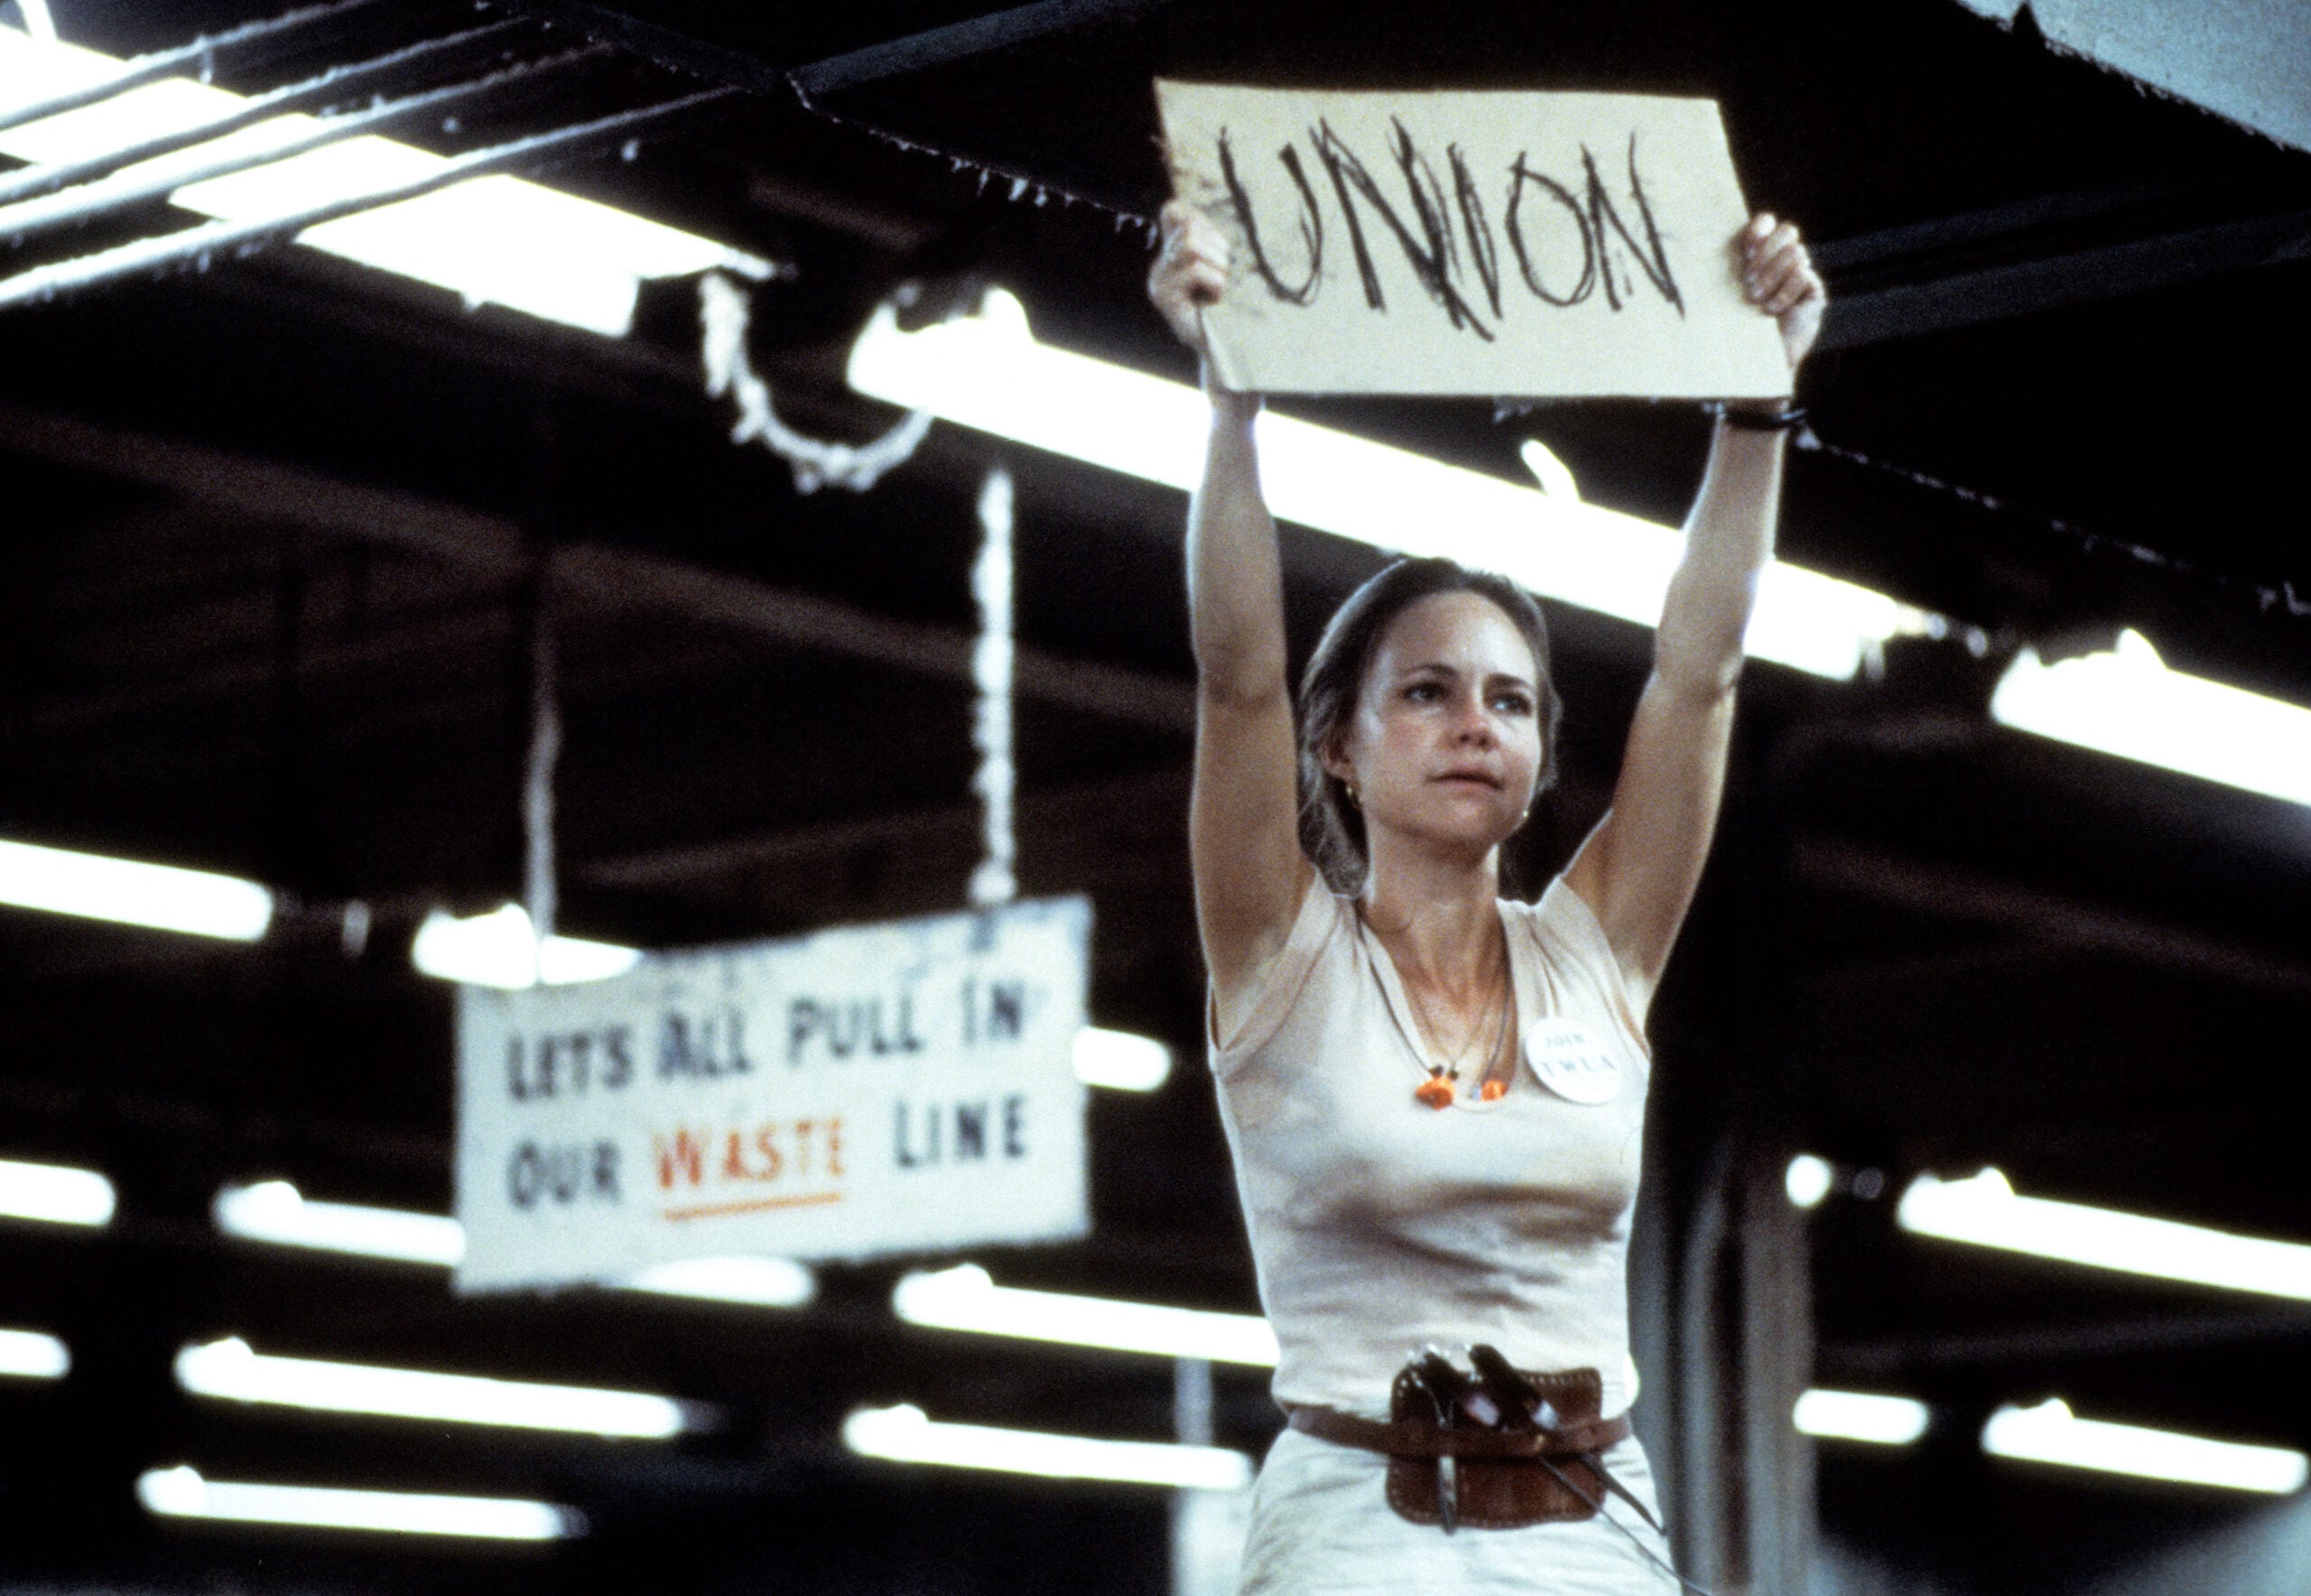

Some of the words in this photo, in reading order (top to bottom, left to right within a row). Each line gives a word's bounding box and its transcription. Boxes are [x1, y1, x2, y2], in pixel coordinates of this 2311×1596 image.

[1215, 114, 1685, 341] UNION
[657, 1005, 752, 1081] ALL
[787, 992, 923, 1068] PULL
[961, 978, 1026, 1047] IN
[507, 1138, 622, 1210] OUR
[653, 1115, 846, 1188] WASTE
[895, 1095, 1028, 1171] LINE
